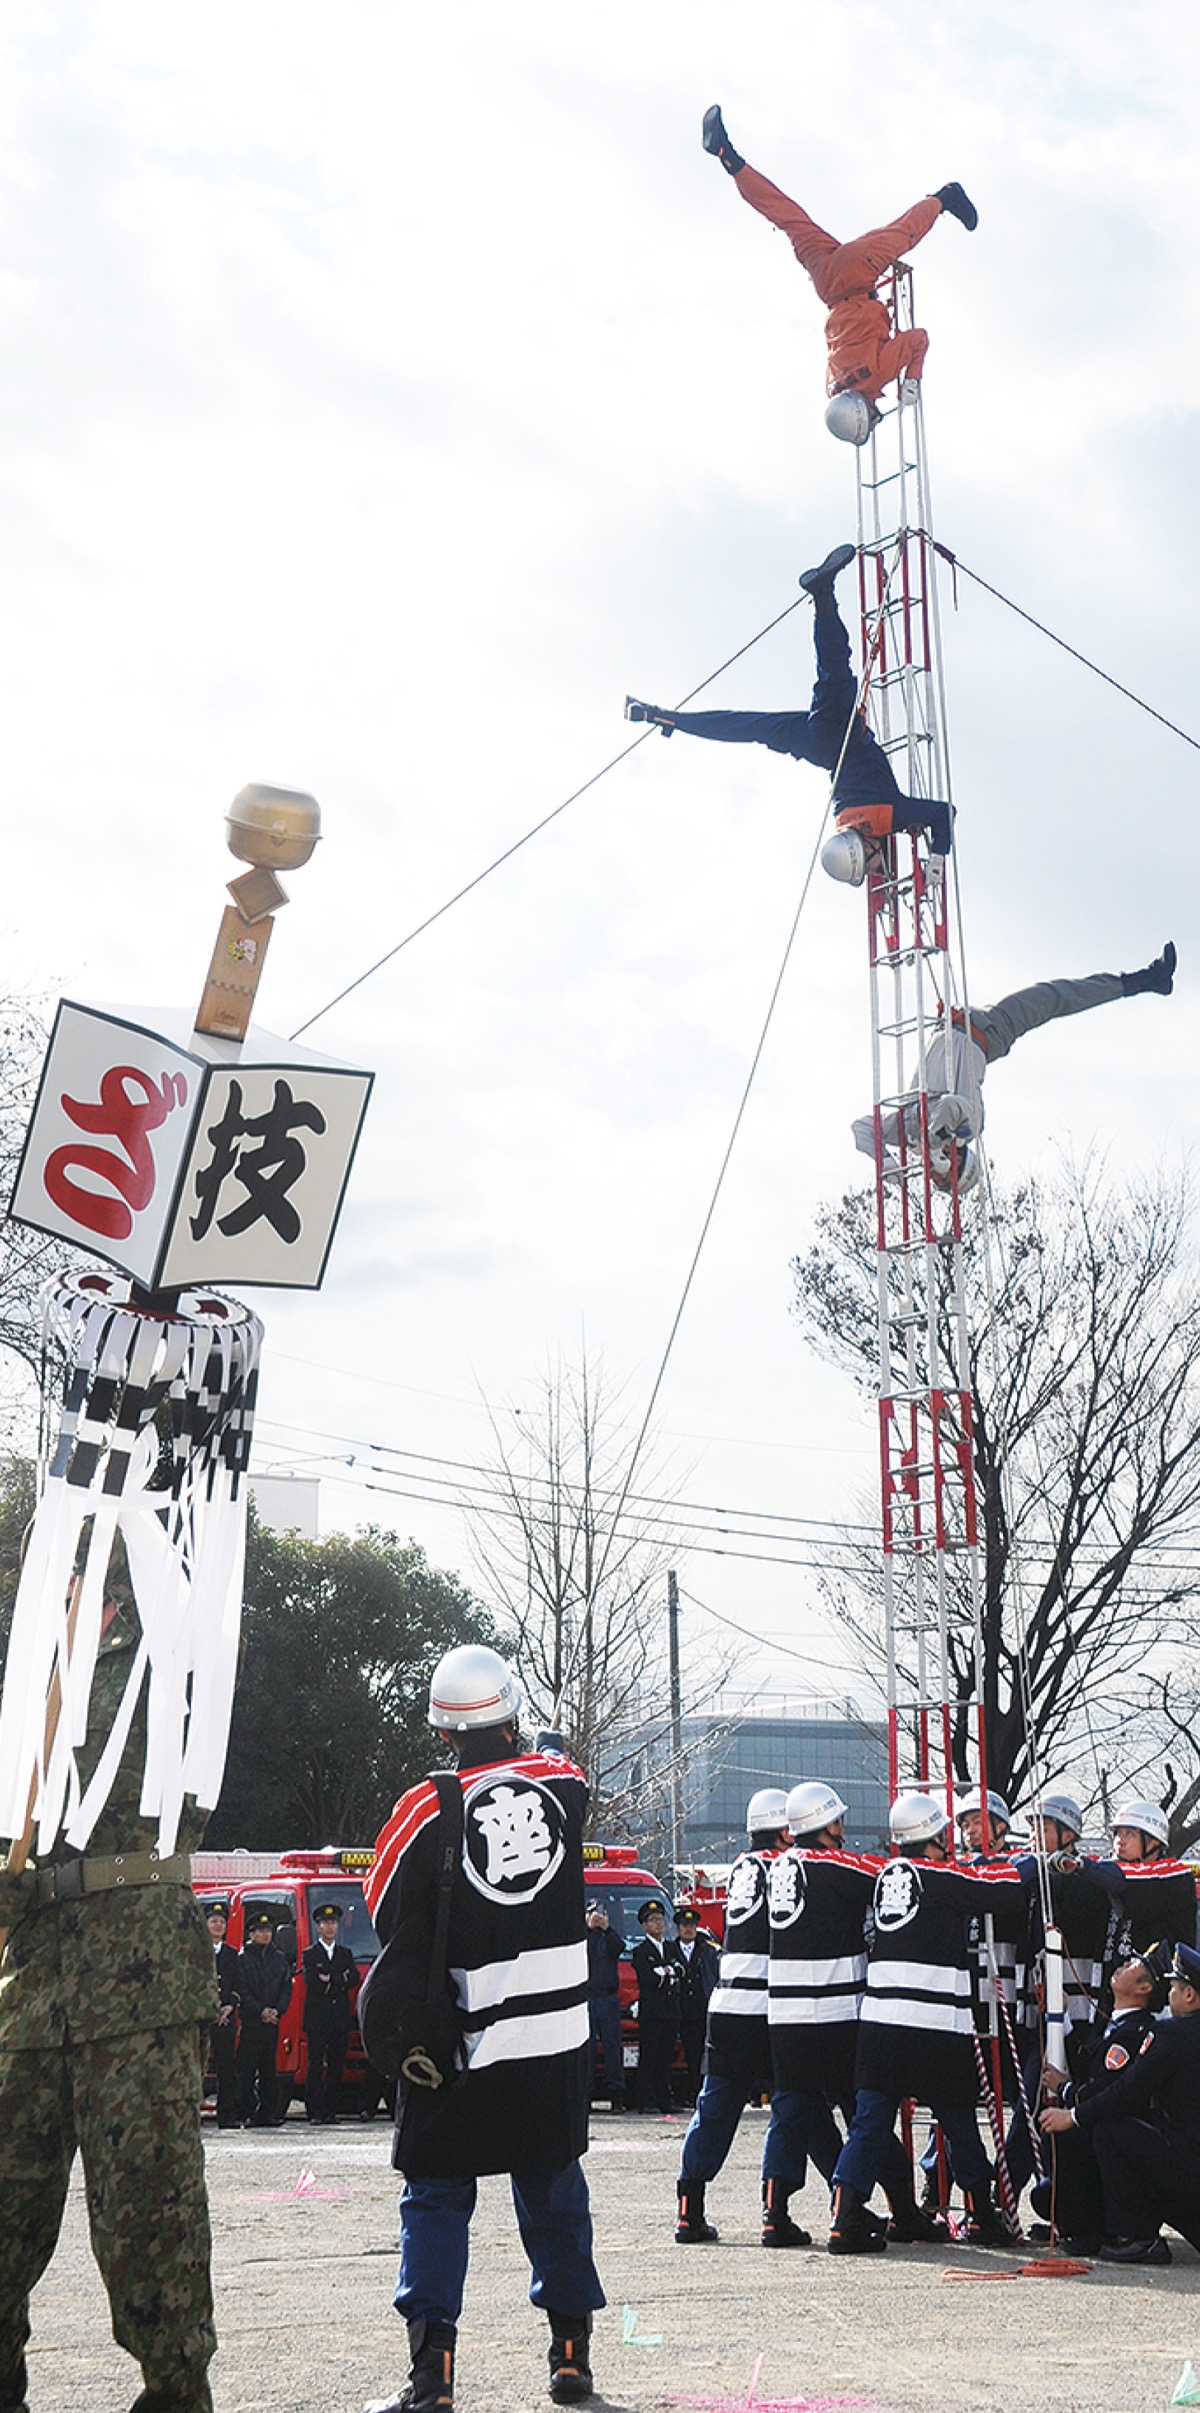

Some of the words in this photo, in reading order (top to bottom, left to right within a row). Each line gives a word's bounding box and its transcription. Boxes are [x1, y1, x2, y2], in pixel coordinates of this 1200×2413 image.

[189, 1079, 326, 1243] 技
[473, 1786, 552, 1885] 座
[880, 1865, 913, 1917] 座
